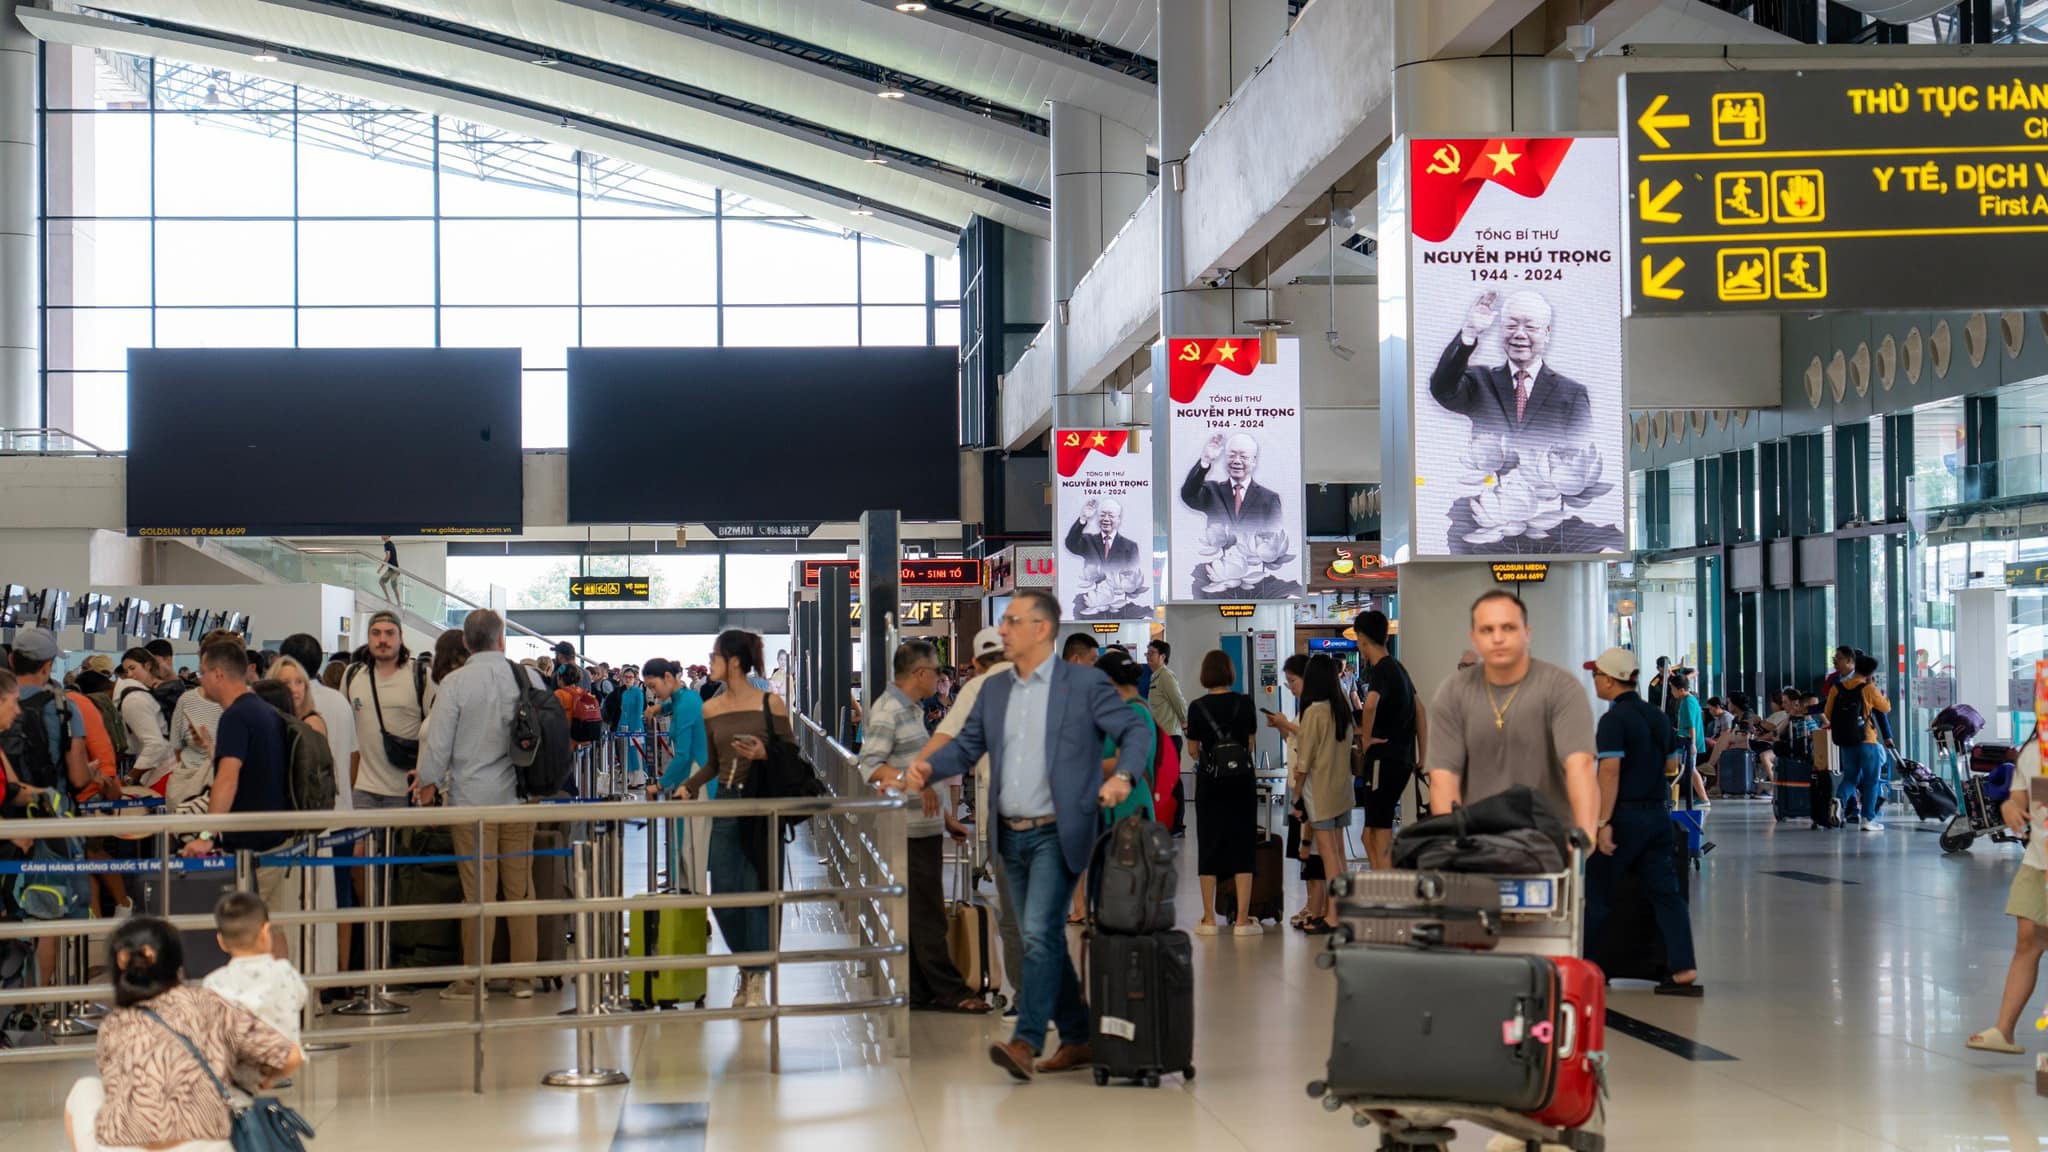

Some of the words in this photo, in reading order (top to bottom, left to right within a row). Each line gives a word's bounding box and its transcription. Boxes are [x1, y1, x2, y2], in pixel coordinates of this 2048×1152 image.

[1846, 82, 1910, 115] THỦ
[1916, 85, 1979, 118] TỤC
[1872, 166, 1895, 192] Y
[1955, 162, 2028, 194] DỊCH
[1979, 194, 2029, 216] First
[1516, 228, 1529, 241] BÍ
[1532, 228, 1560, 241] THƯ
[1423, 245, 1499, 264] NGUYỄN
[1504, 247, 1543, 264] PHÚ
[1547, 249, 1612, 267] TRỌNG
[1470, 269, 1508, 282] 1944
[1524, 268, 1563, 281] 2024
[1227, 406, 1252, 417] PHÚ
[1254, 408, 1295, 419] TRỌNG
[1206, 420, 1230, 428] 1944
[1240, 420, 1264, 428] 2024
[139, 527, 180, 536] GOLDSUN
[191, 527, 207, 536] 090
[208, 527, 224, 536] 464
[225, 527, 246, 536] 6699
[718, 525, 754, 536] BIZMAN
